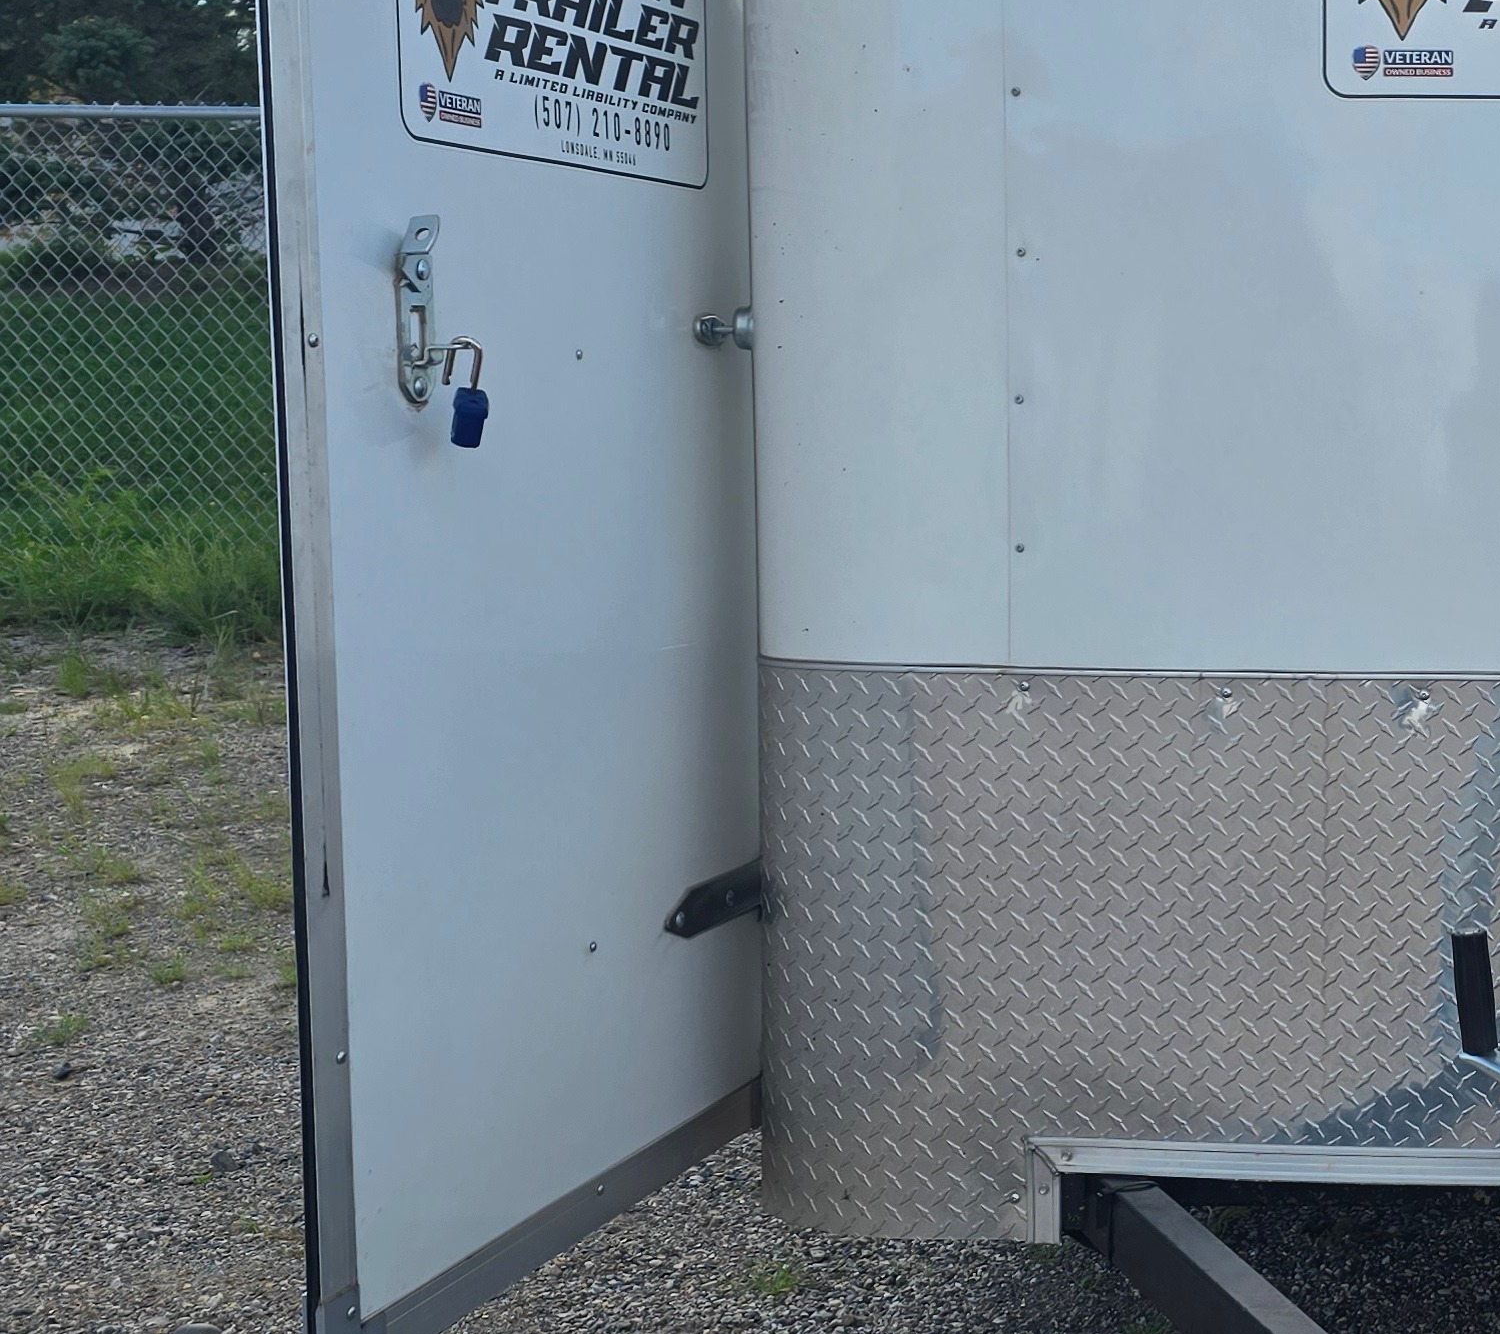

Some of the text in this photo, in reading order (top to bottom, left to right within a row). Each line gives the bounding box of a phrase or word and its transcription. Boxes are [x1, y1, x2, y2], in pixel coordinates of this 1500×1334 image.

[1478, 18, 1498, 30] A
[484, 13, 700, 109] RENTAL
[1384, 51, 1453, 64] VETERAN
[1385, 68, 1451, 76] OWNED BUSINESS
[439, 92, 480, 114] VETERAN
[494, 69, 698, 124] A LIMITED LIABILITY COMPANY
[534, 94, 671, 152] (507) 210-8890
[560, 139, 600, 160] LONSDALE,
